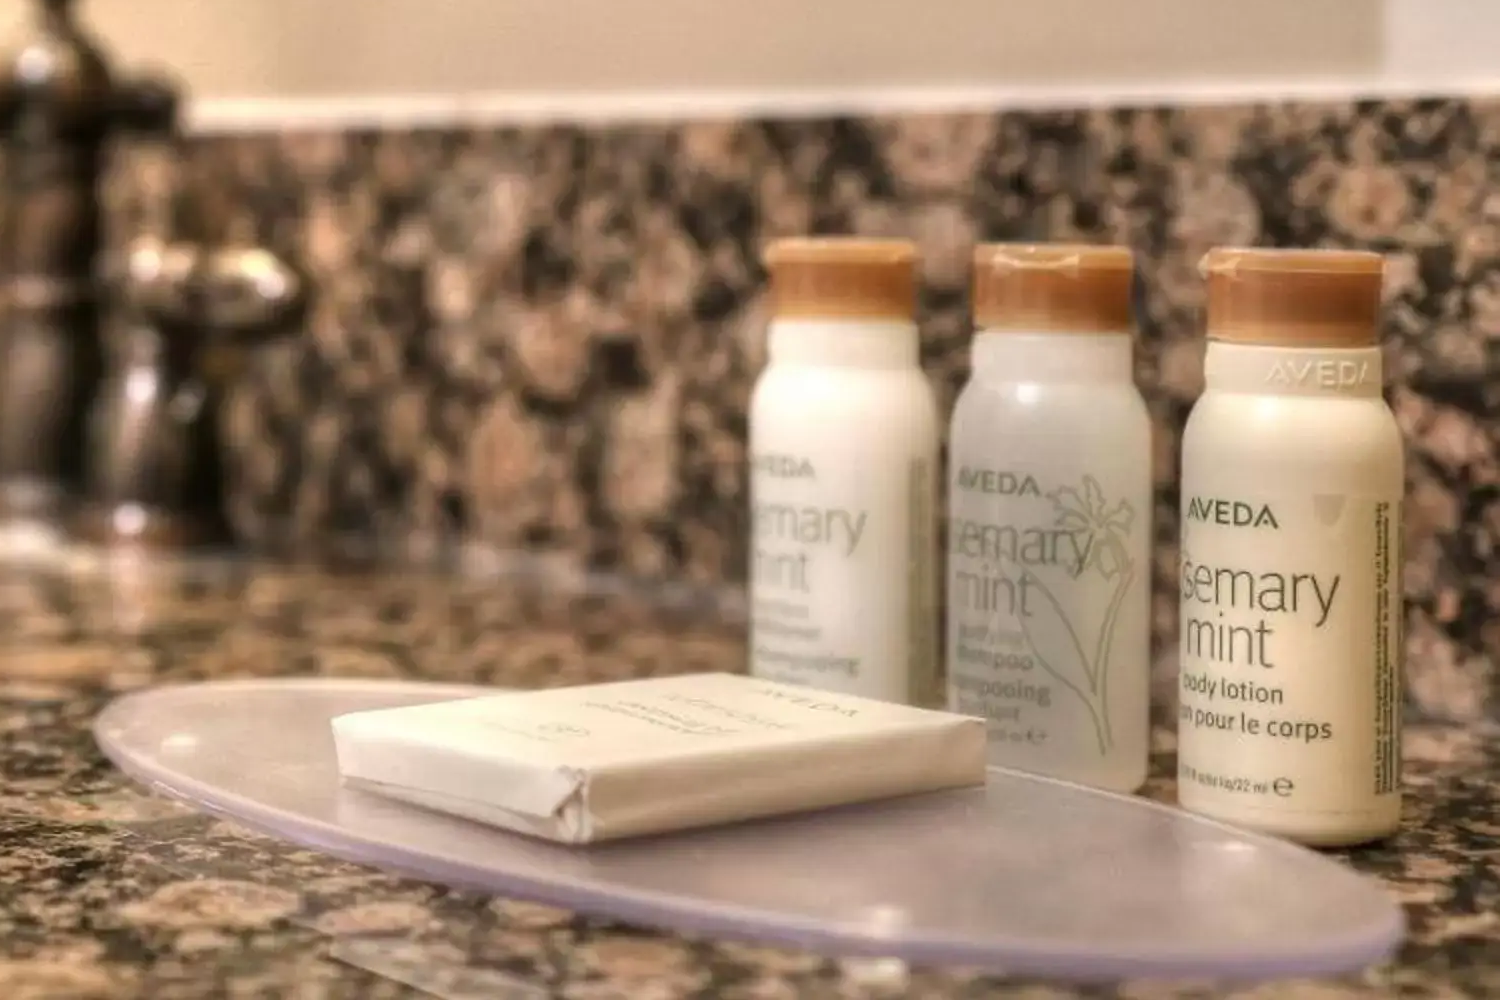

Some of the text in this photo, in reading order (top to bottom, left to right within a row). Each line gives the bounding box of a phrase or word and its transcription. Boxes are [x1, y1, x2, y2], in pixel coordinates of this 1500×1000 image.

[1187, 497, 1279, 530] AVEDA
[1186, 610, 1275, 669] mint
[1221, 681, 1284, 705] lotion
[1195, 708, 1235, 731] pour
[1241, 711, 1260, 736] le
[1266, 722, 1333, 744] corps
